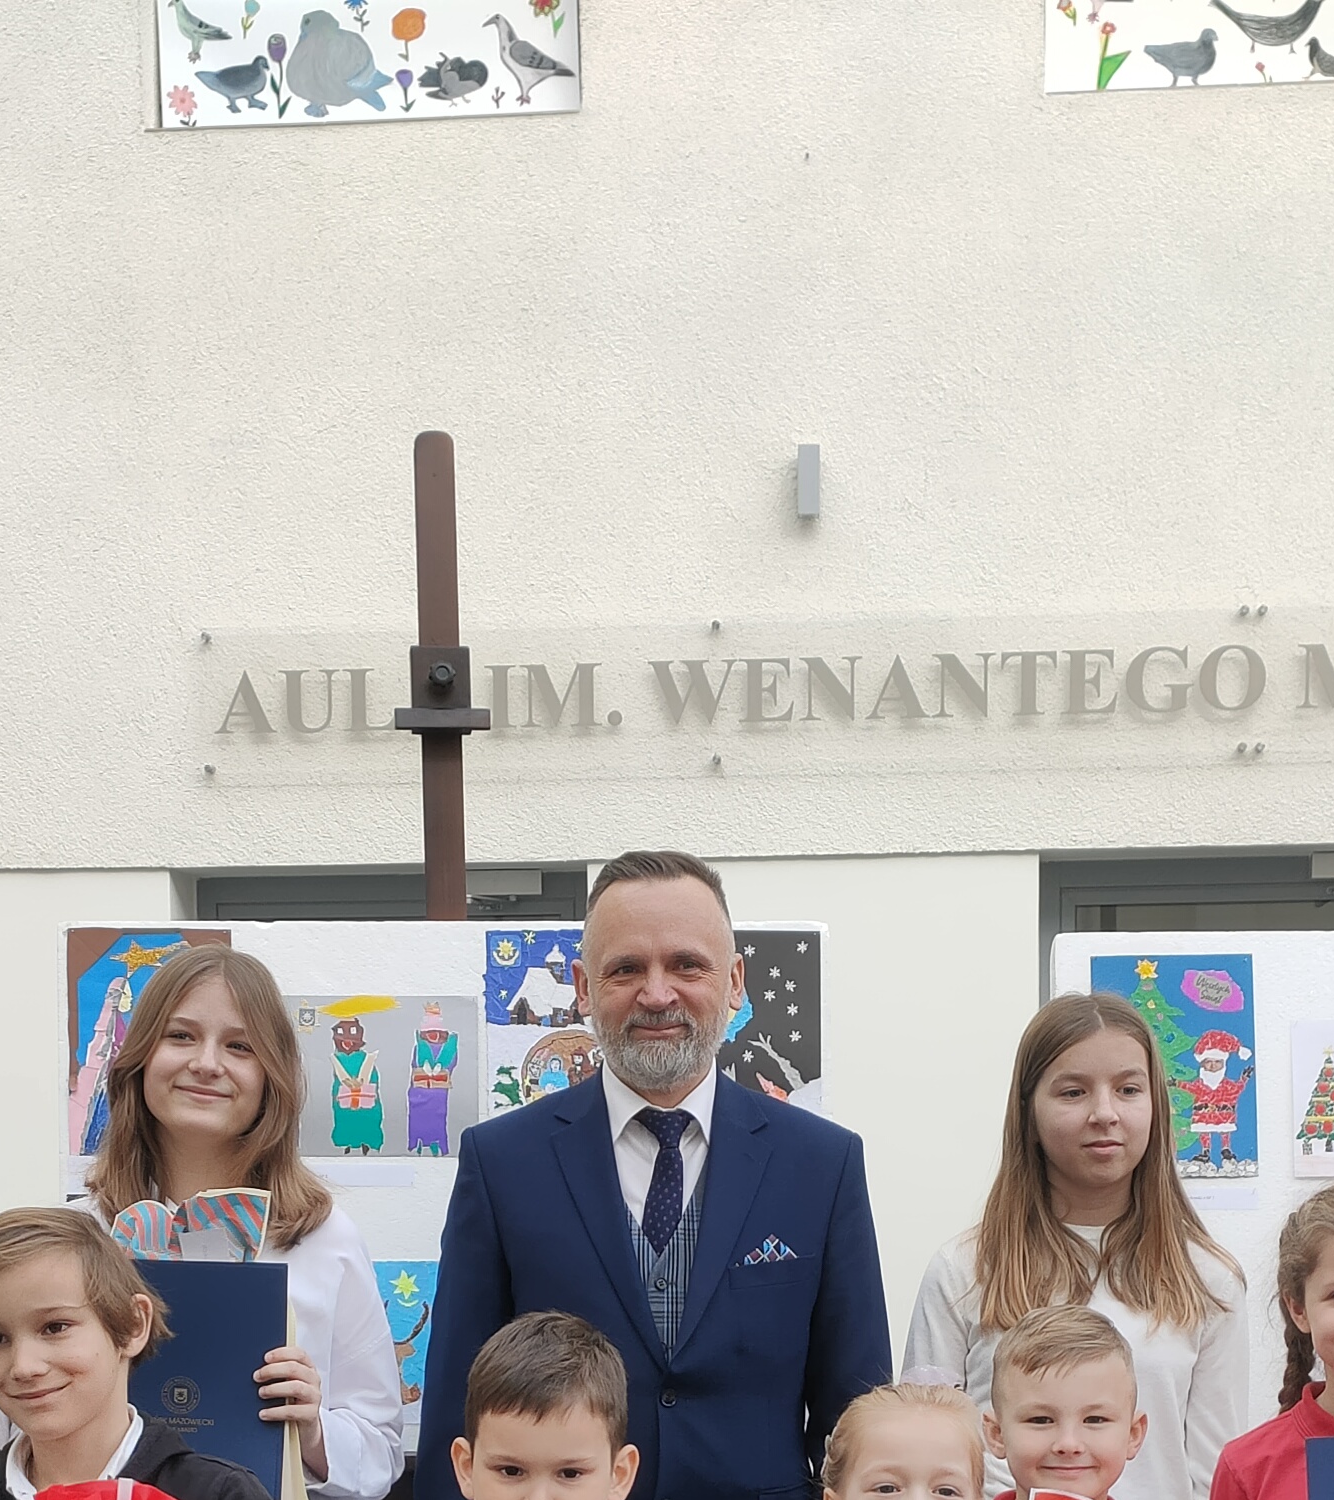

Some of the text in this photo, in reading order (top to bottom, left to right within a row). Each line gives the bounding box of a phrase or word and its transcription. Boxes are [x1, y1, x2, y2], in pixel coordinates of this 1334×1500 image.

[215, 668, 412, 734] AUL
[484, 662, 624, 729] IM.
[648, 644, 1267, 725] WENANTEGO
